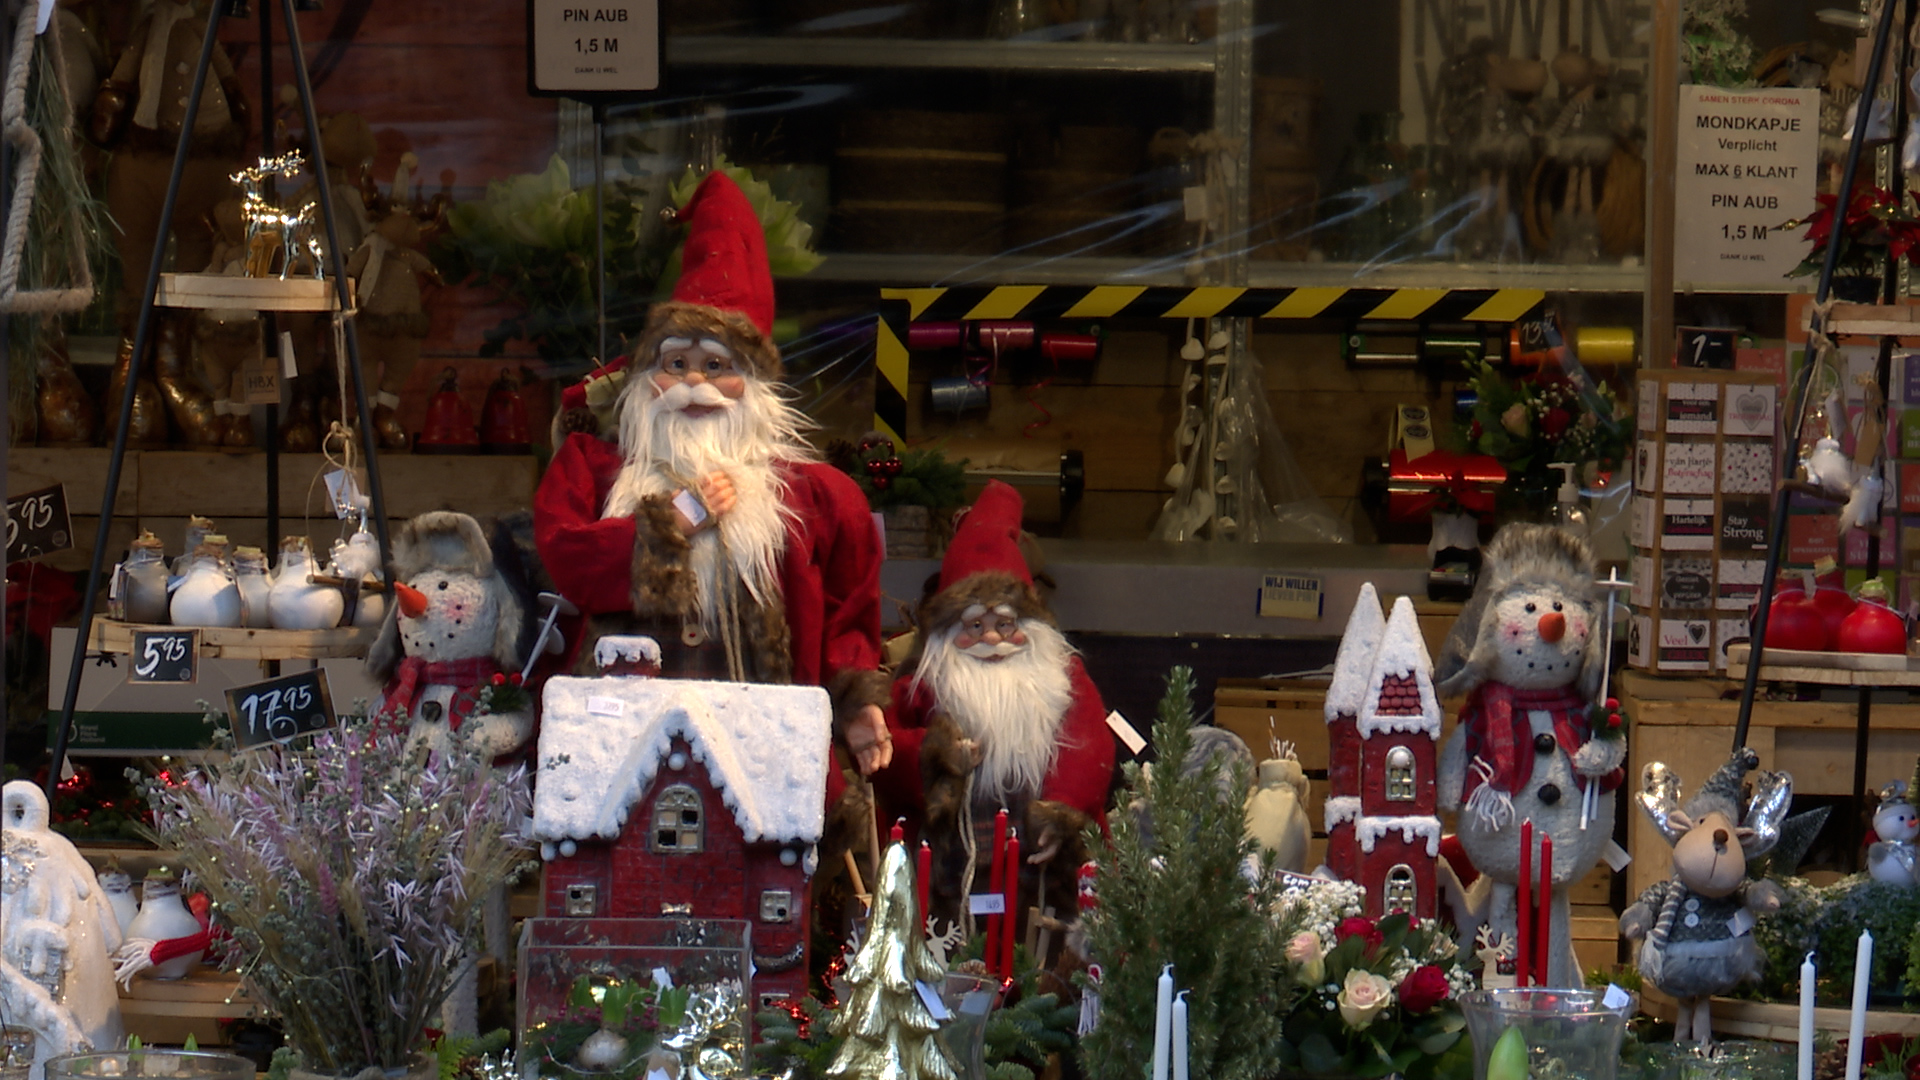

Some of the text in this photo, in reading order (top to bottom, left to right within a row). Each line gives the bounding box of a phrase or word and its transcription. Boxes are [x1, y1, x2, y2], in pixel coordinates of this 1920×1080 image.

[563, 9, 628, 22] PIN AUB
[574, 38, 619, 55] 1,5 M
[1698, 95, 1800, 106] SAMEN STERK CORONA
[1696, 115, 1801, 132] MONDKAPJE
[1718, 138, 1777, 152] Verplicht
[1695, 163, 1798, 179] MAX 6 KLANT
[1711, 194, 1779, 209] PIN AUB
[1721, 224, 1768, 240] 1,5 M
[248, 375, 275, 389] HBX
[1671, 515, 1707, 527] Hartelijk
[1727, 515, 1748, 527] Stay
[1722, 525, 1765, 541] Strong
[1265, 576, 1319, 591] WIJ WILLEN
[1663, 635, 1688, 645] Veel
